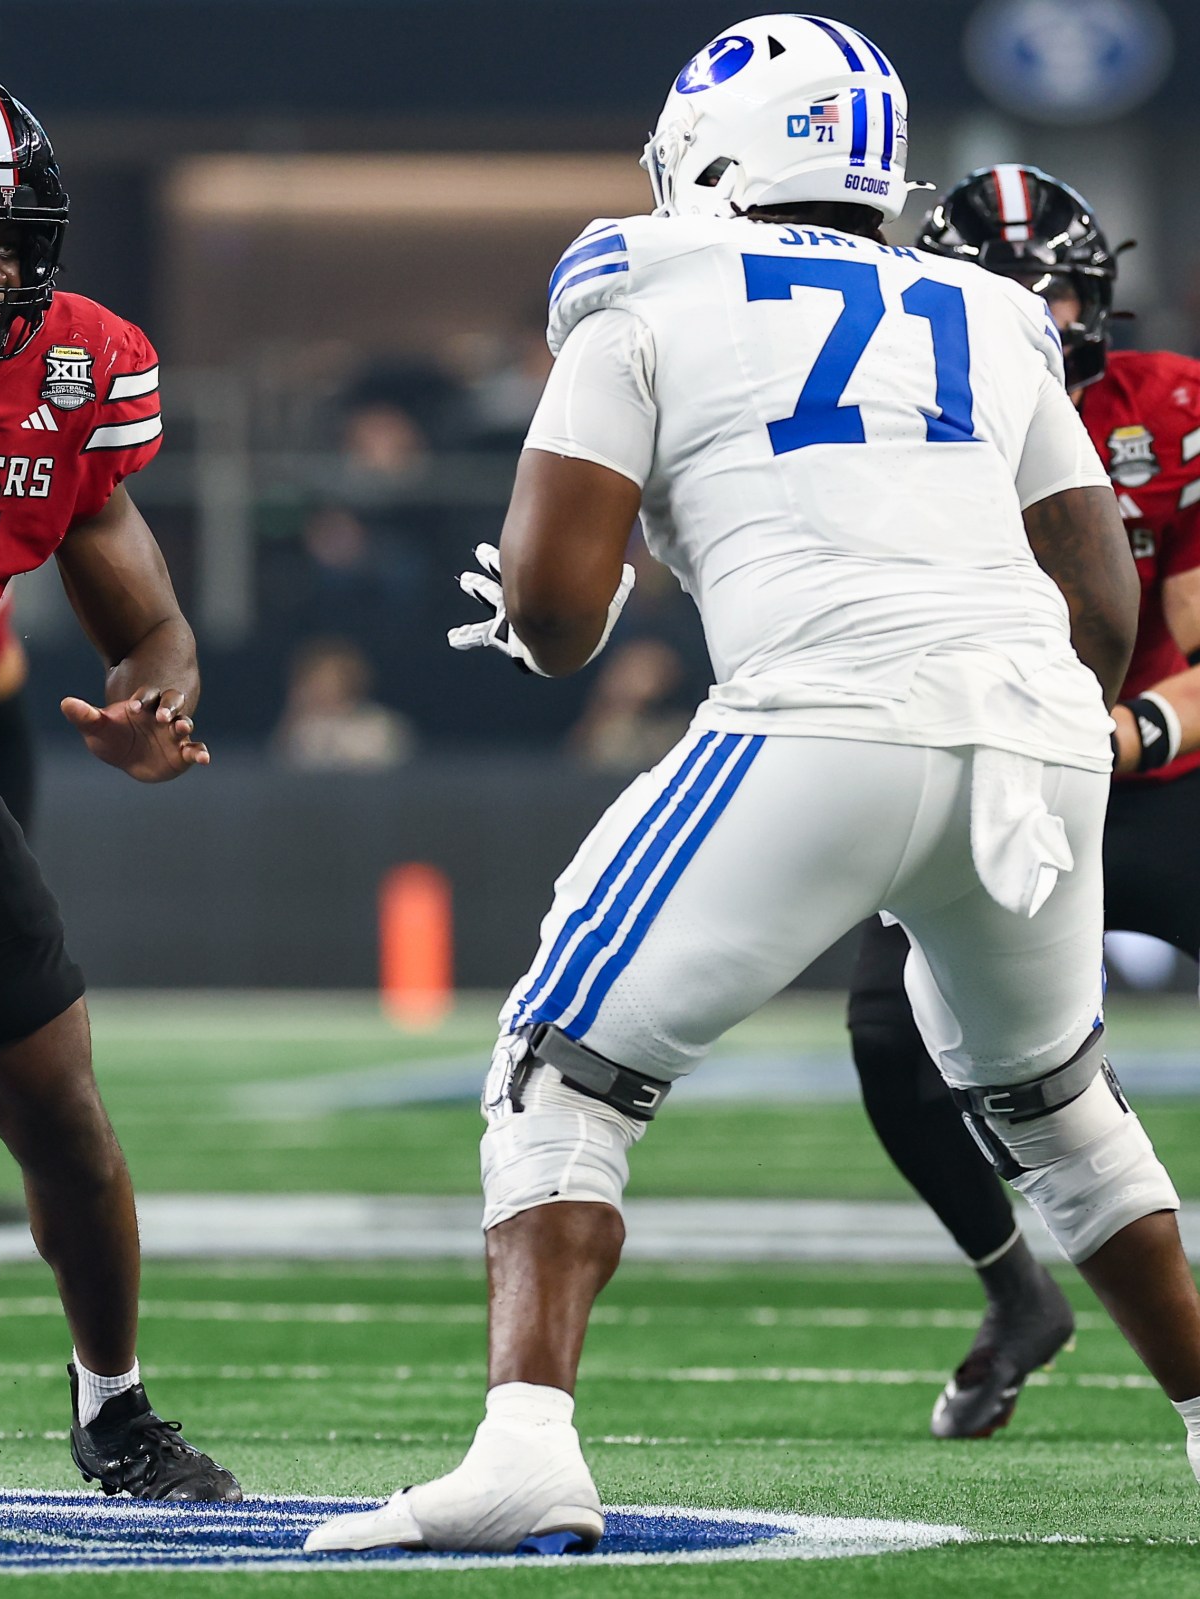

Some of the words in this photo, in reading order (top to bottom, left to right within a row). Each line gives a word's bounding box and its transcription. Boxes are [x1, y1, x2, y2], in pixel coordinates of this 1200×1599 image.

[815, 125, 835, 142] 71
[844, 173, 860, 190] GO
[860, 176, 890, 196] COUGS
[741, 253, 988, 456] 71
[46, 358, 93, 383] XII
[41, 388, 96, 399] CHAMPIONSHIP
[51, 385, 87, 393] FOOTBALL
